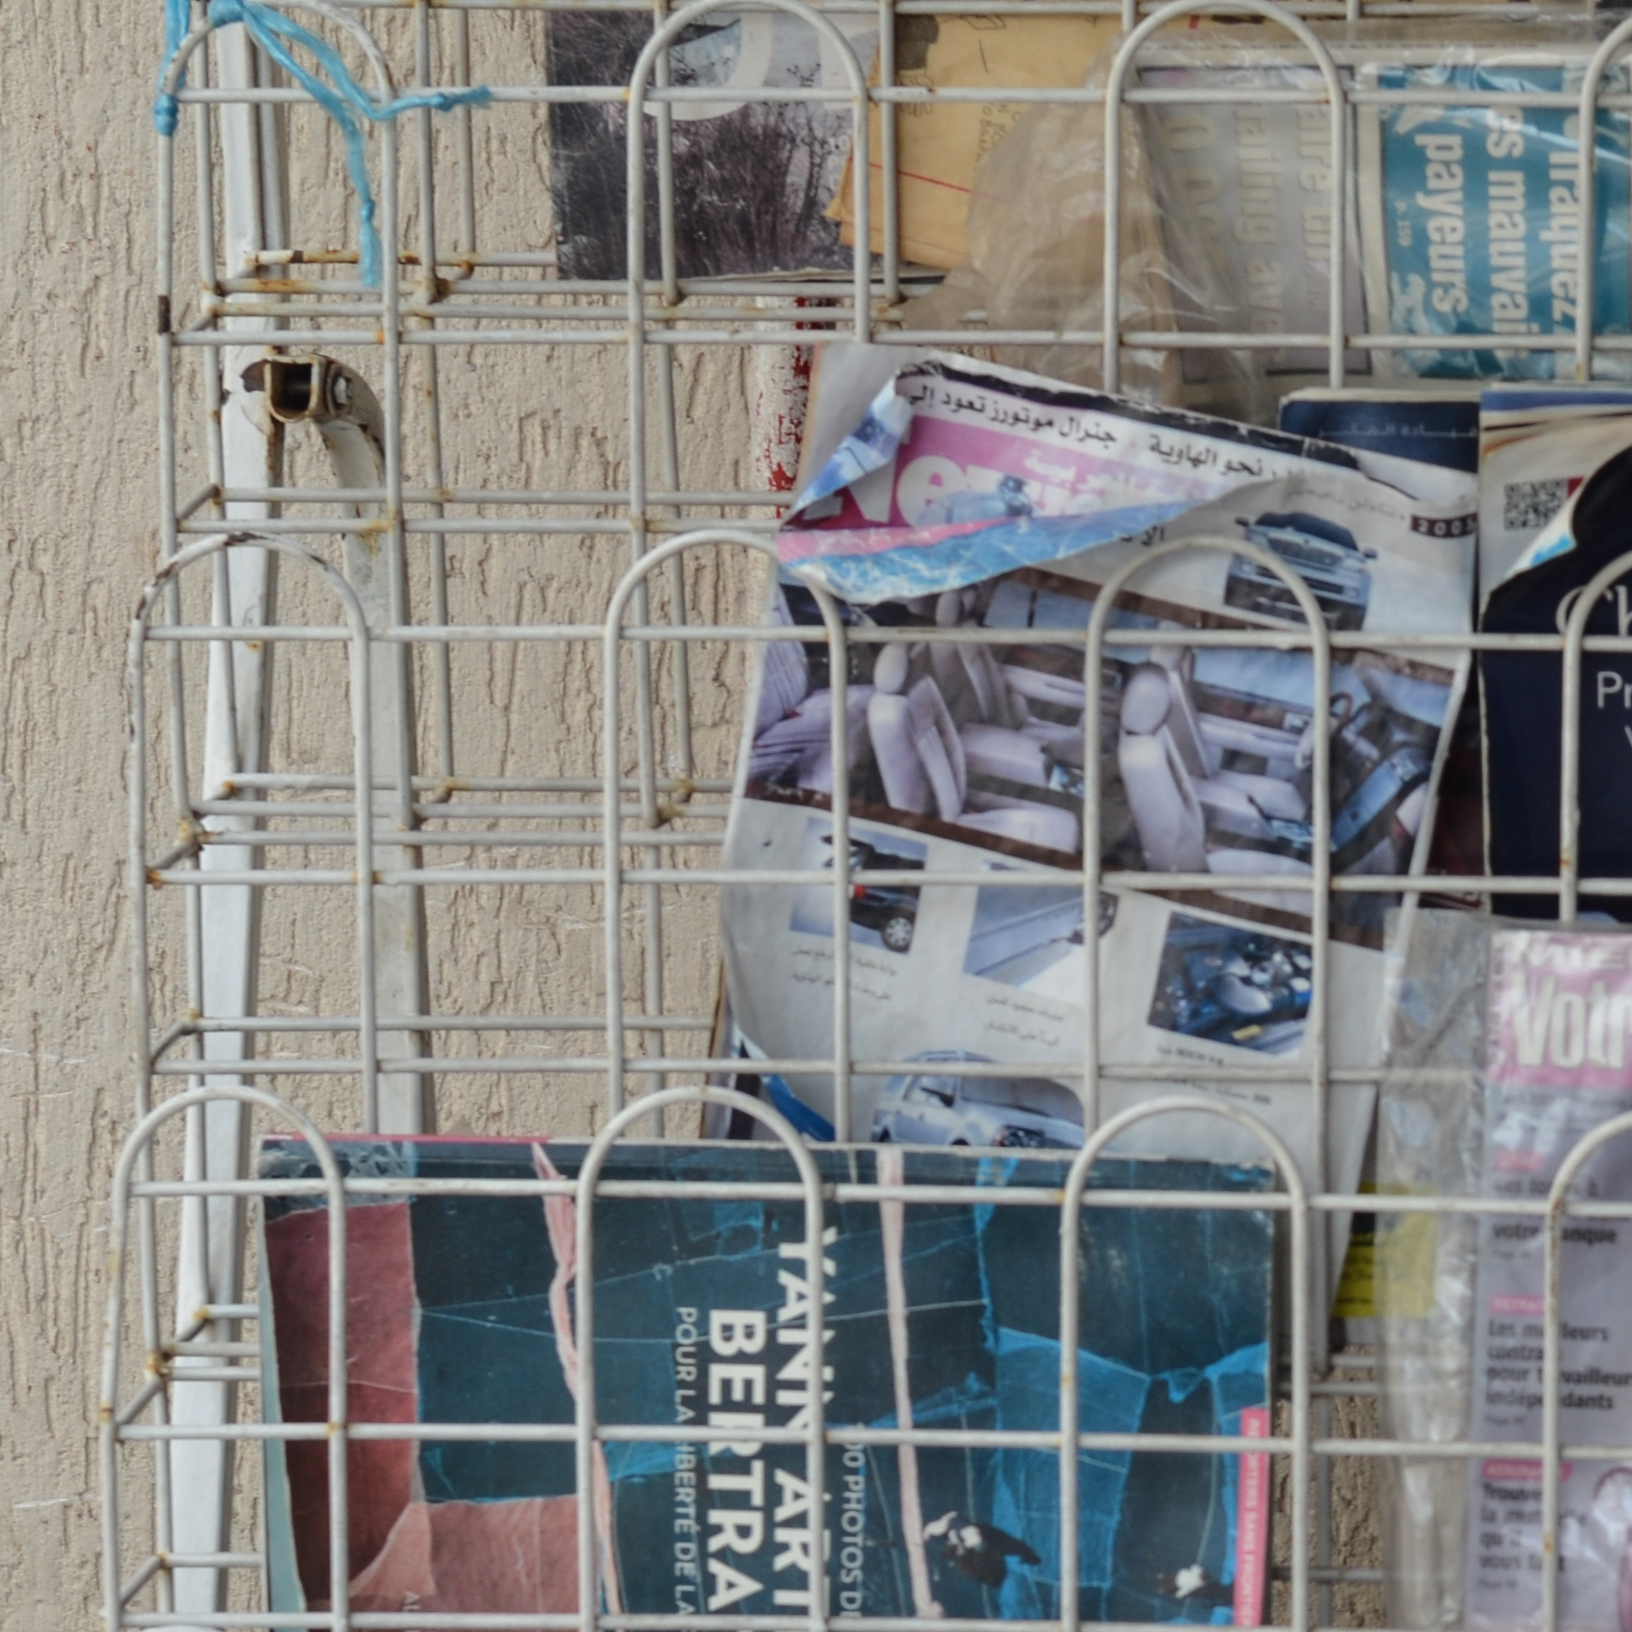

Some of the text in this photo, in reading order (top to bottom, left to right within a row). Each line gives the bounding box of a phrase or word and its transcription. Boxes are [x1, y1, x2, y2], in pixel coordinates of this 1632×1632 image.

[1410, 130, 1474, 314] payeurs
[674, 1305, 698, 1381] POUR
[840, 1470, 866, 1587] PHOTOS
